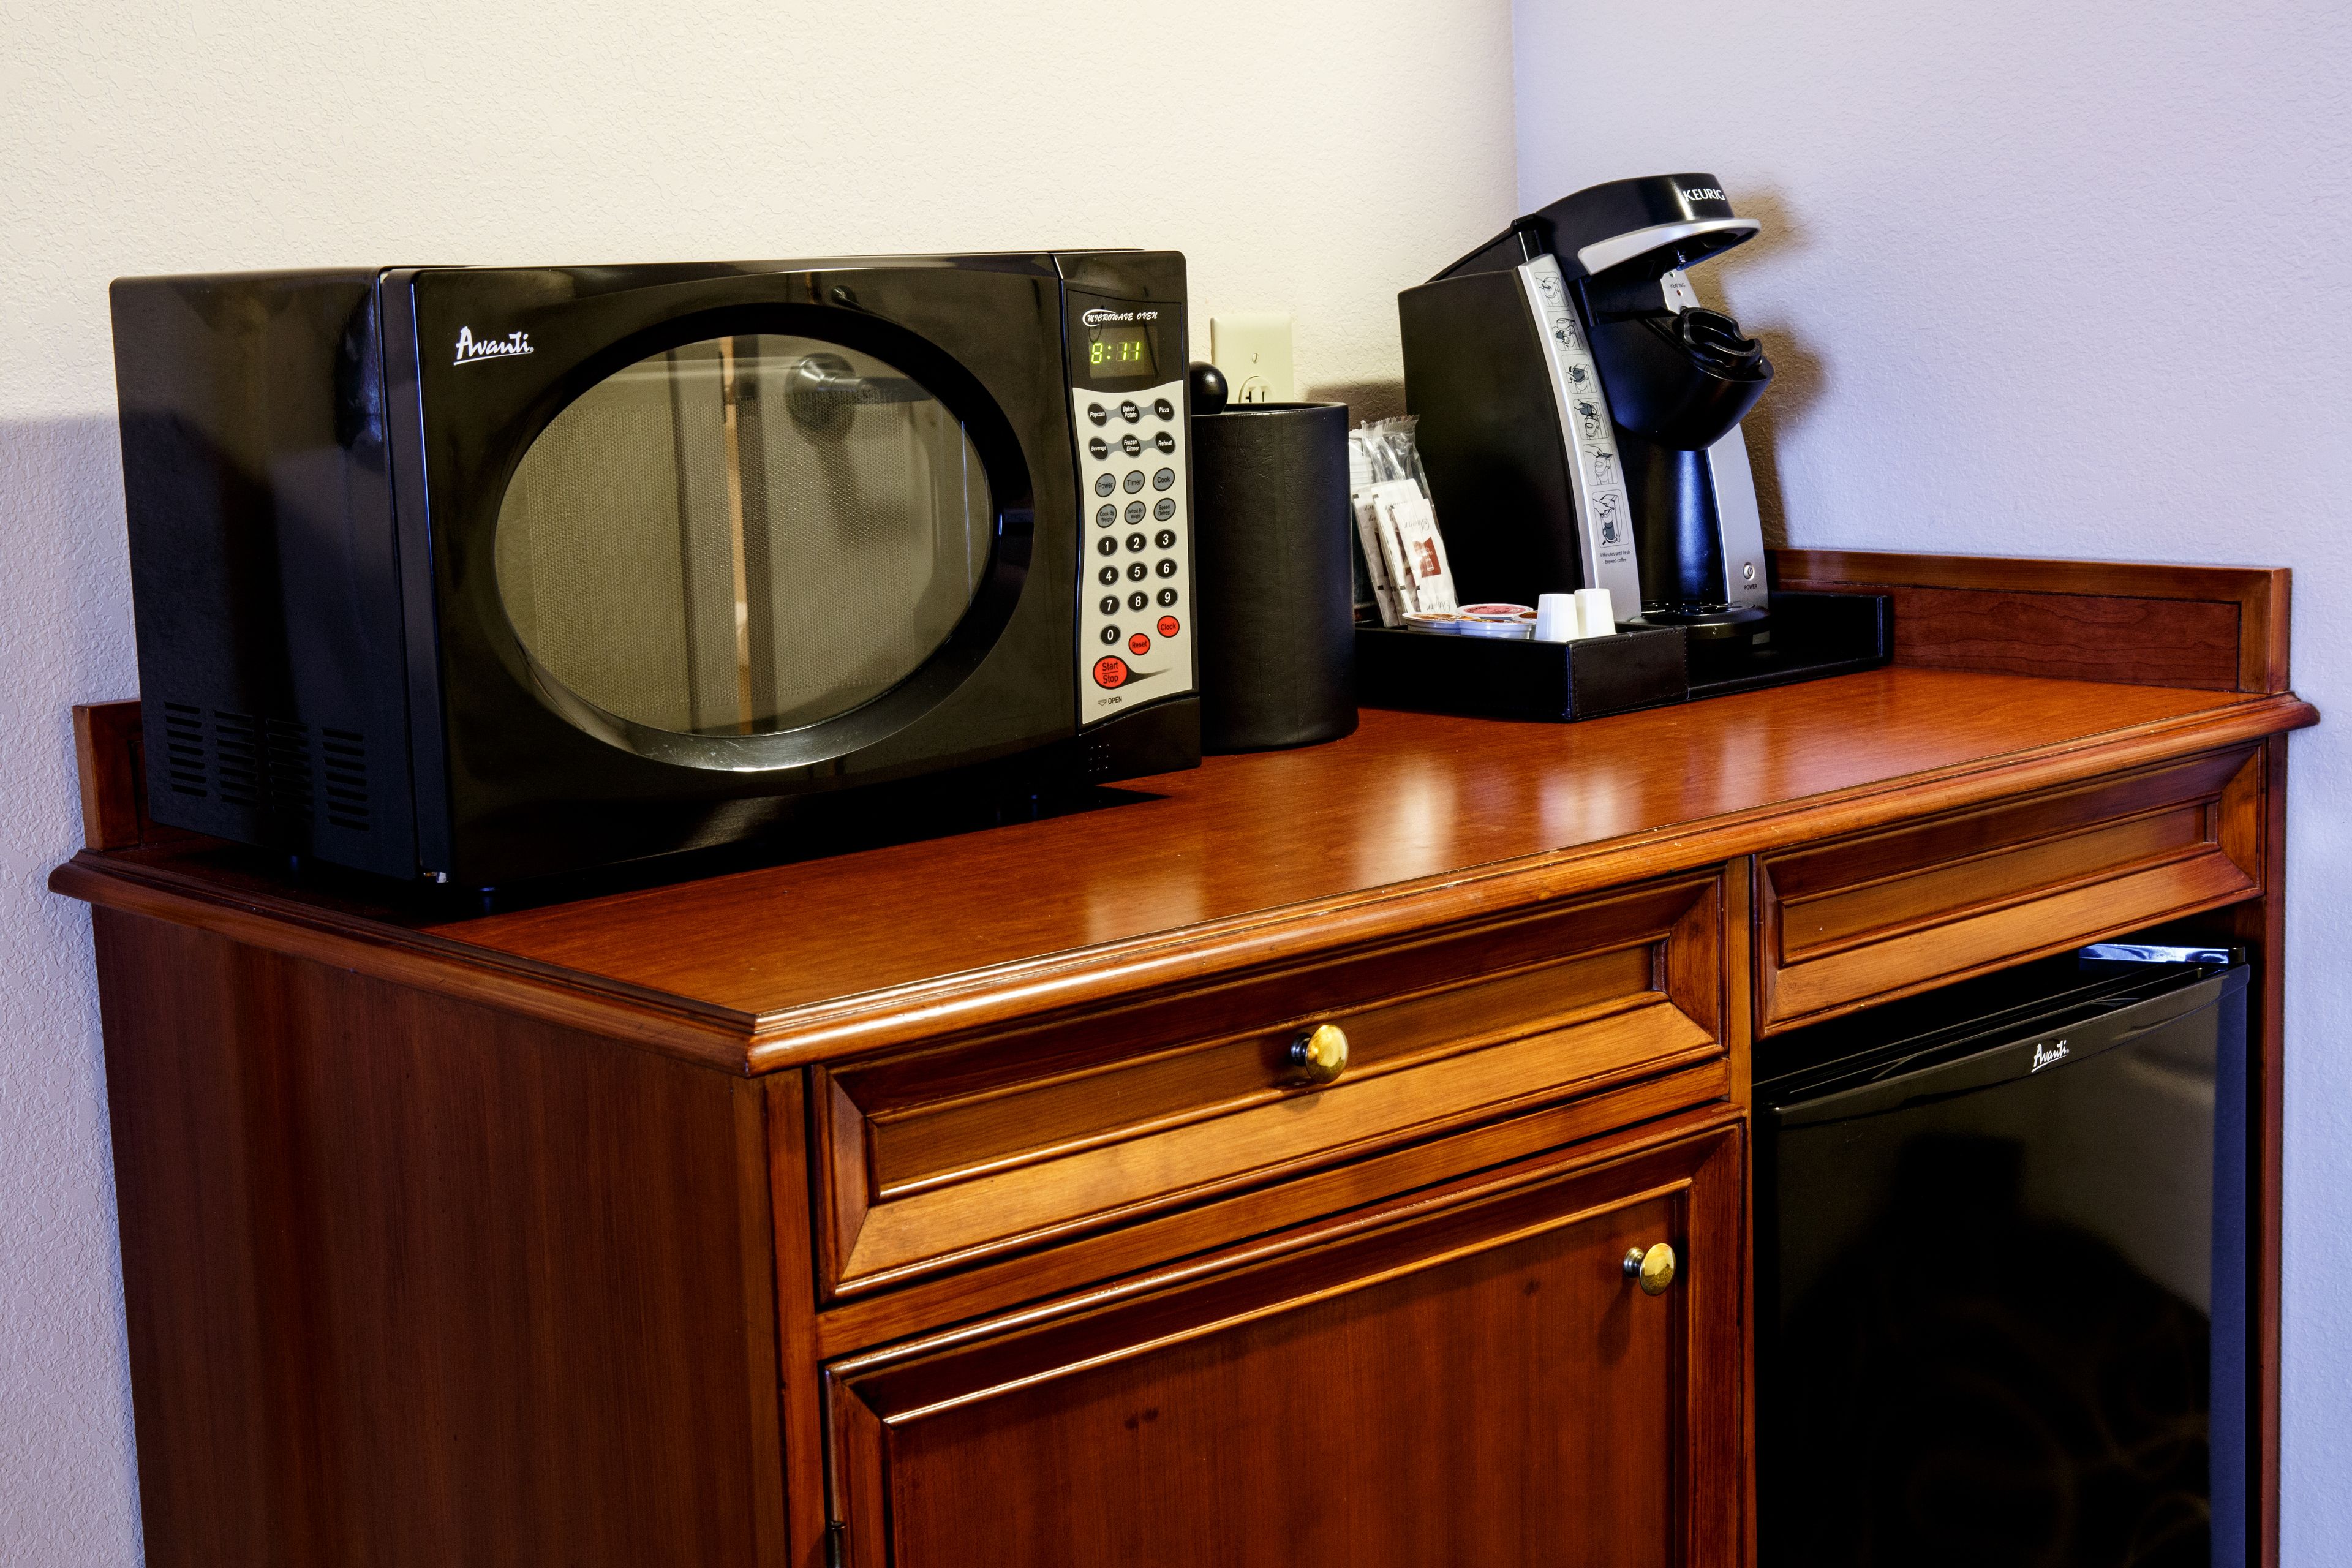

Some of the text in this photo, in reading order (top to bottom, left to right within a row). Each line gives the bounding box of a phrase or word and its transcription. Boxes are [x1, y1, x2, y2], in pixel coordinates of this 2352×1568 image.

[1683, 189, 1725, 202] KEURIG
[1087, 311, 1158, 322] MICROWAVE OVEN
[455, 326, 529, 360] Avanti
[1091, 342, 1140, 364] 8:11
[1133, 537, 1140, 549] 2
[1163, 533, 1169, 545] 3
[1106, 541, 1109, 552] 1
[1134, 566, 1140, 578] 5
[1163, 563, 1170, 574] 6
[1106, 570, 1112, 581] 4
[1135, 596, 1142, 607] 8
[1164, 592, 1171, 603] 9
[1107, 600, 1113, 611] 7
[1107, 629, 1114, 641] 0
[1102, 661, 1118, 672] Start
[1102, 674, 1119, 684] Stop
[2033, 1039, 2067, 1068] Avanti
